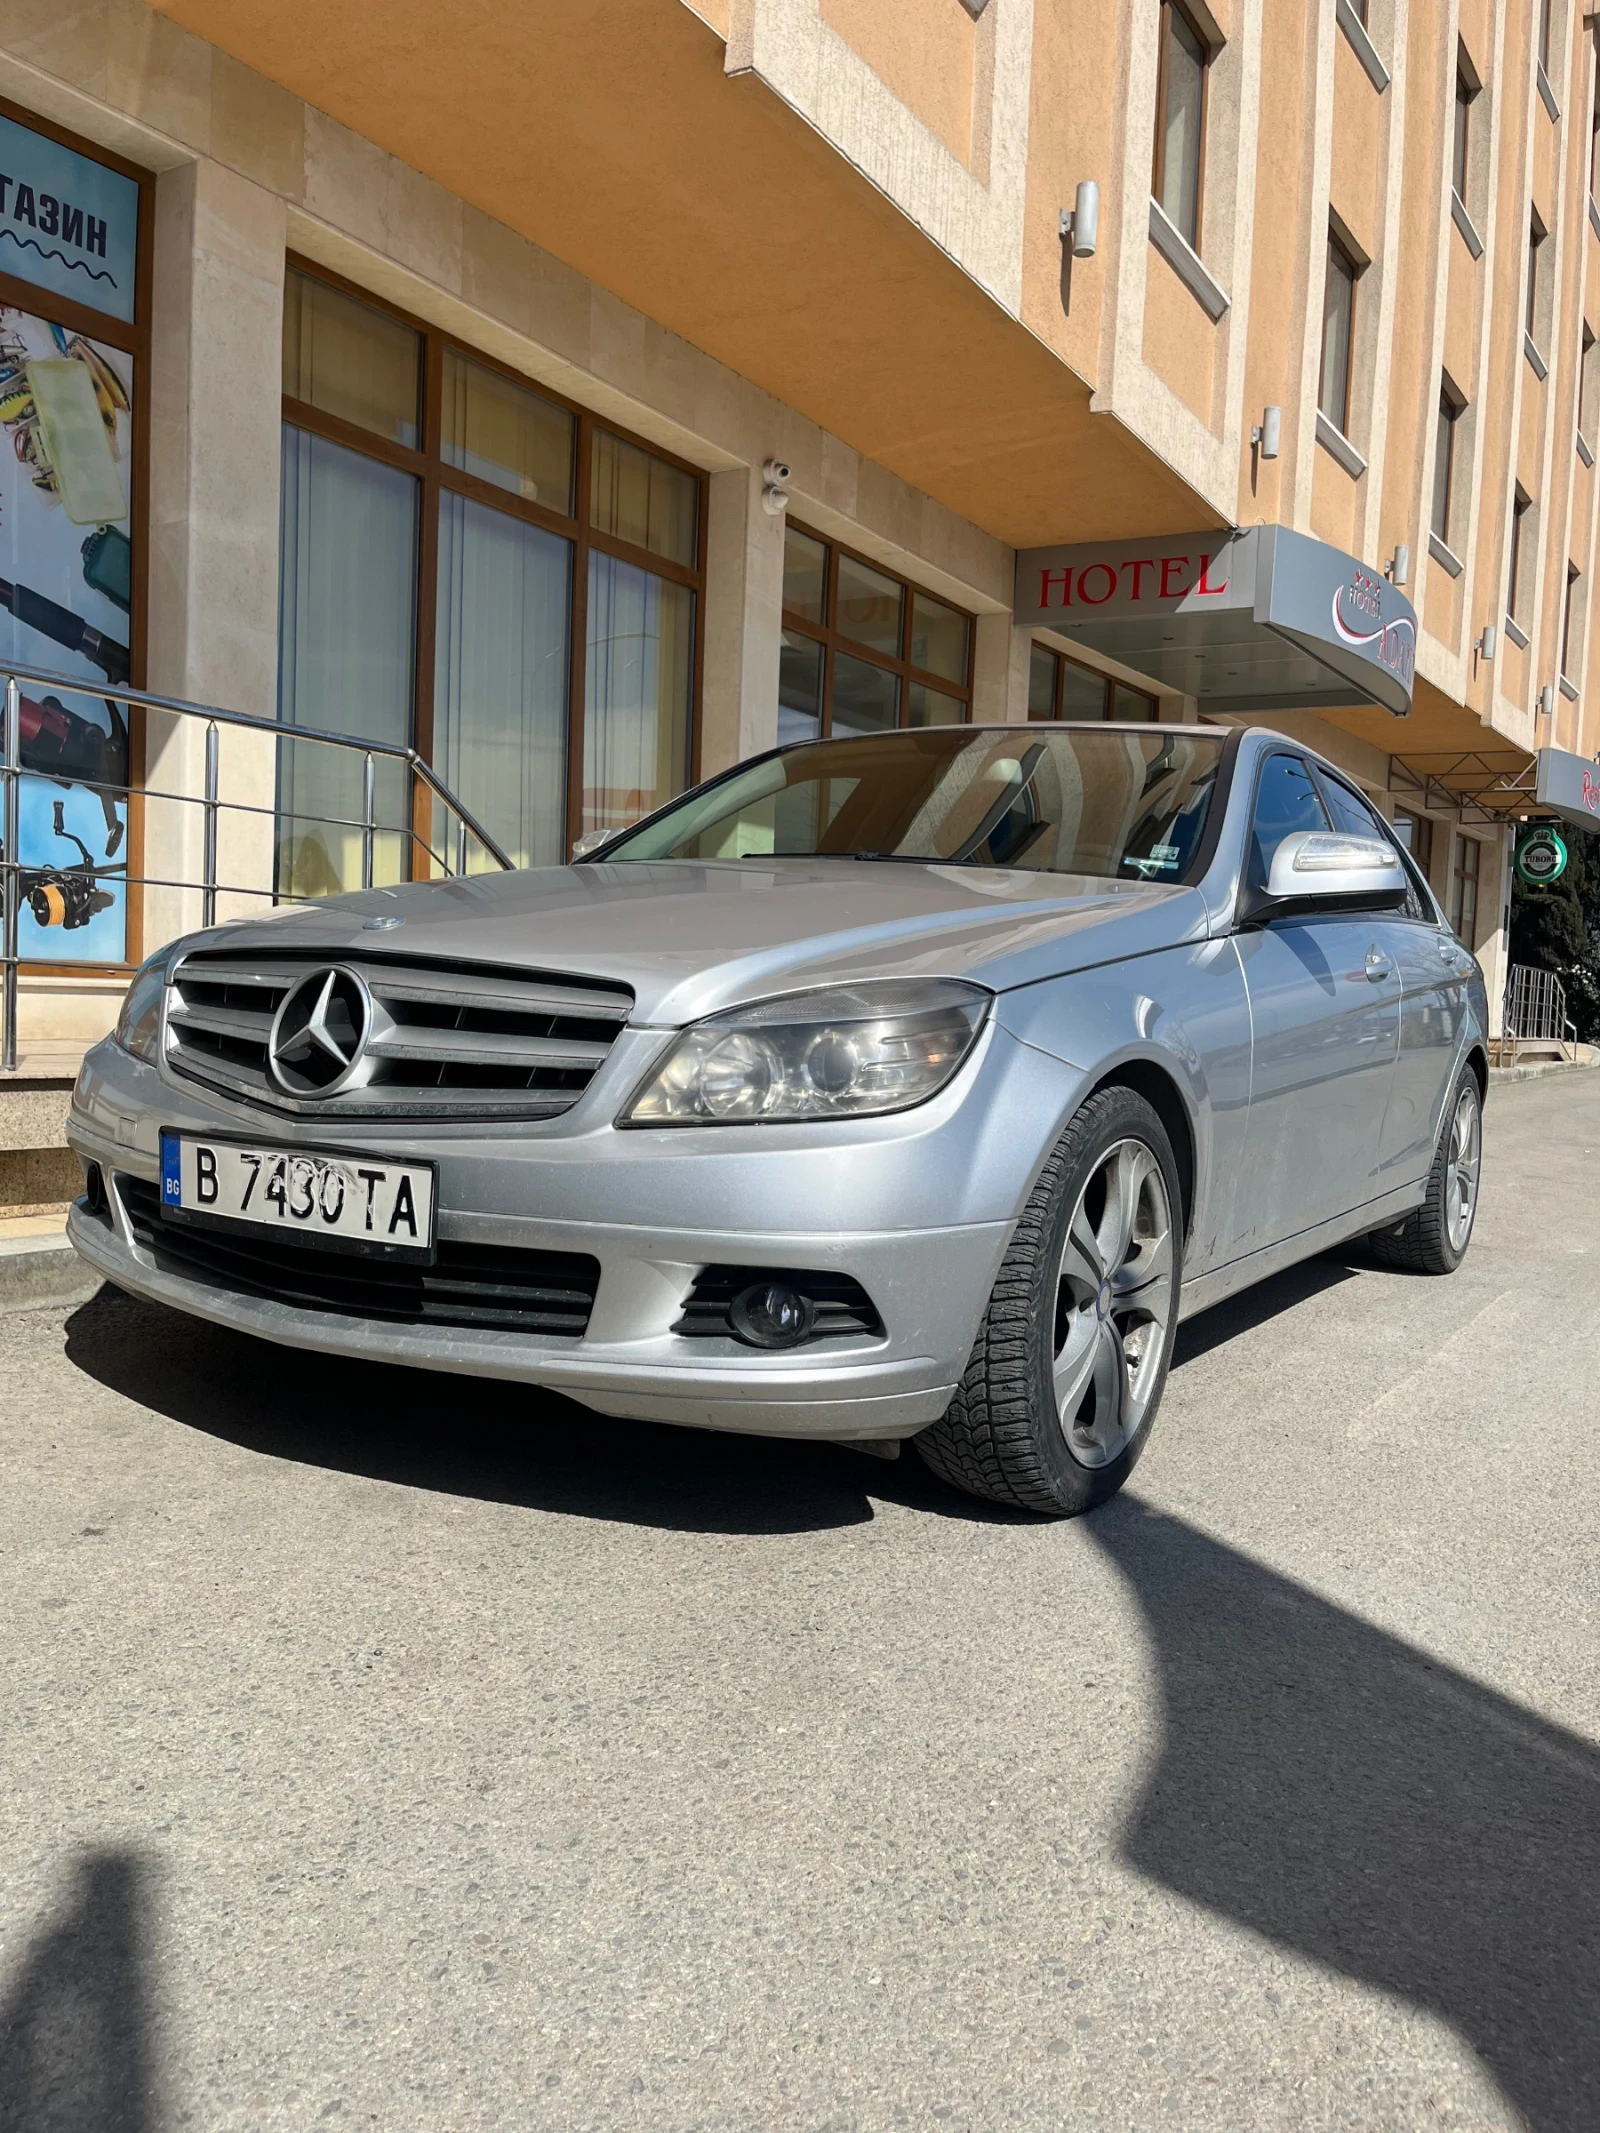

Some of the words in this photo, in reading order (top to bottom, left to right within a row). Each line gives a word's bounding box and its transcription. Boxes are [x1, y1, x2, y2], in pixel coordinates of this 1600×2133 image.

[1037, 554, 1230, 609] HOTEL
[1348, 584, 1382, 620] HOTEL
[1524, 855, 1557, 863] TUBORG
[166, 1178, 180, 1196] BG
[358, 1168, 418, 1238] TA
